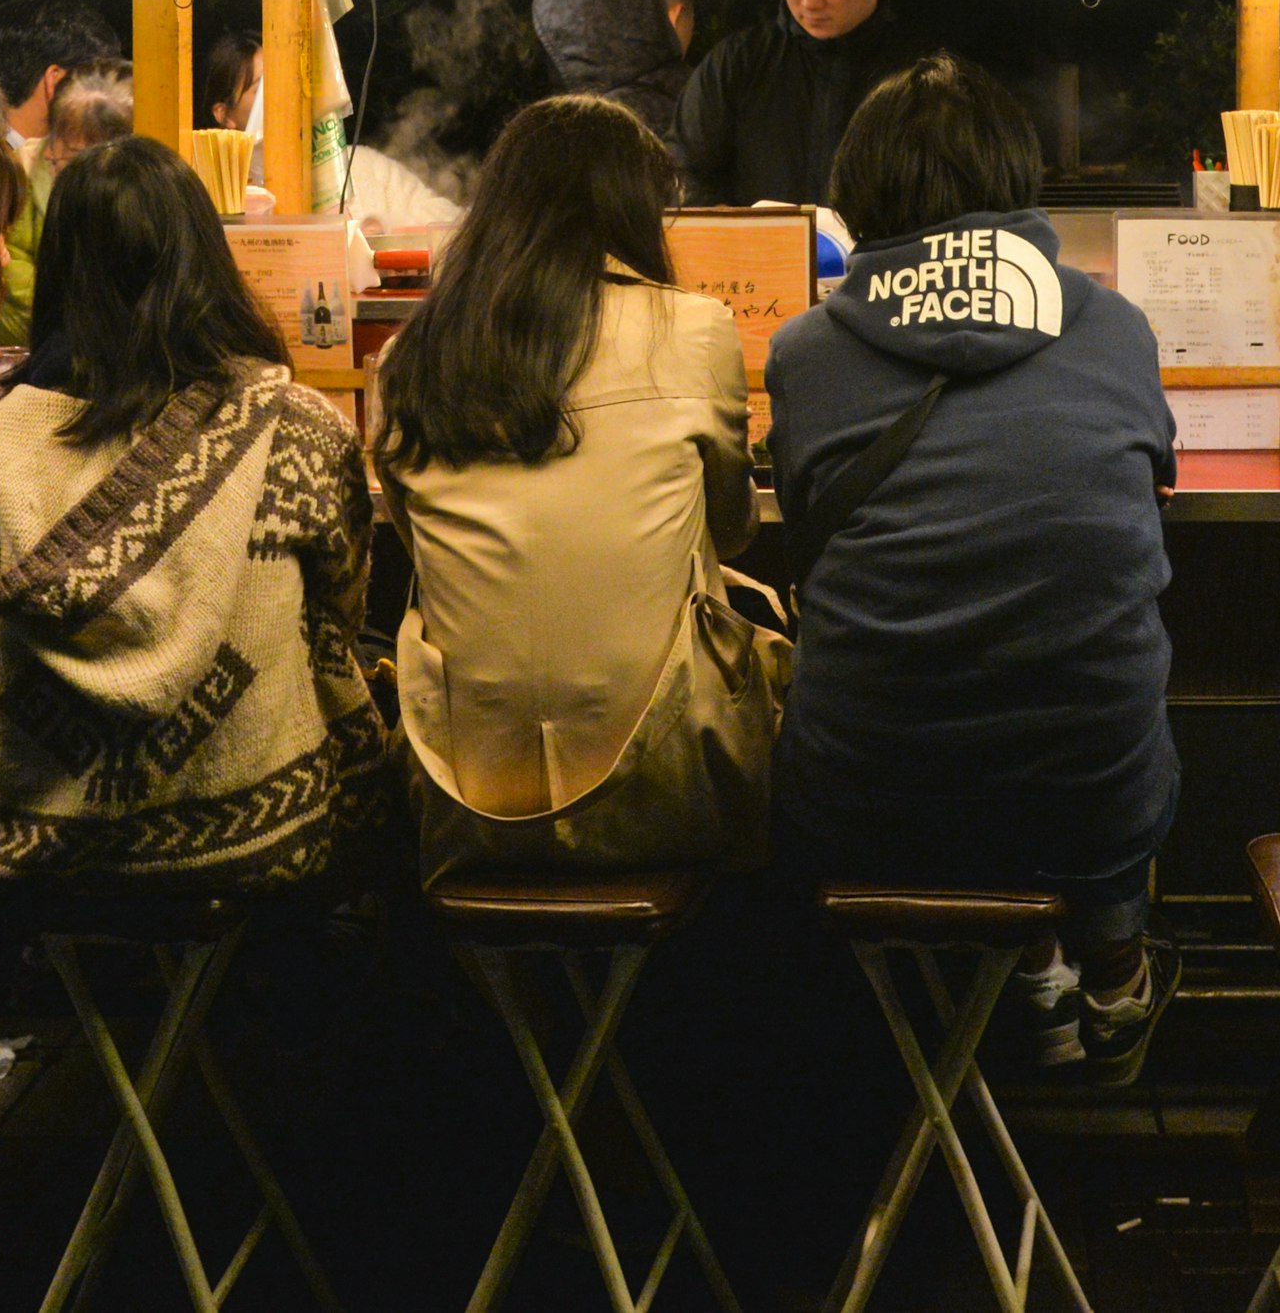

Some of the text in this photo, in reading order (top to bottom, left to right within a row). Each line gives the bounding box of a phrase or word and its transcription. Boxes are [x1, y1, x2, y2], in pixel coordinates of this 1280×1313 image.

[923, 230, 994, 261] THE
[1167, 233, 1210, 246] FOOD
[868, 258, 994, 303] NORTH
[901, 289, 995, 326] FACE
